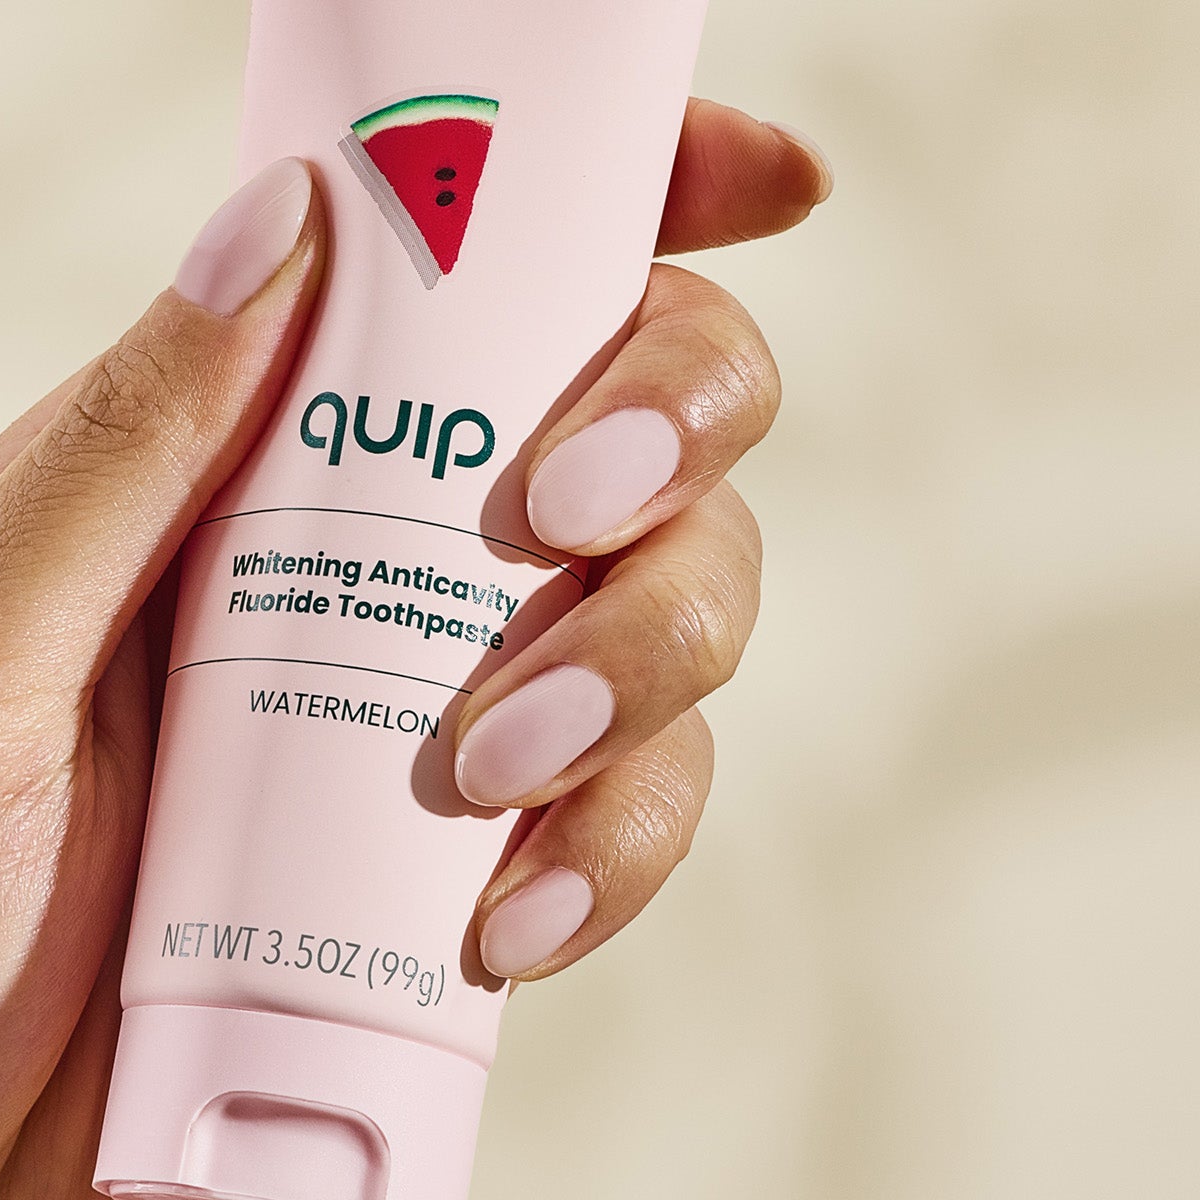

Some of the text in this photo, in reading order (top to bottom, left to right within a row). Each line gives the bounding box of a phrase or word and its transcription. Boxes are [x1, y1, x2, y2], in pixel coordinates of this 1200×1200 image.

[299, 391, 496, 480] quip
[228, 587, 505, 650] Fluoride Toothpaste
[232, 549, 520, 621] Whitening Anticavity
[249, 689, 440, 740] WATERMELON
[161, 922, 446, 1007] NET WT 3.5OZ (99g)
